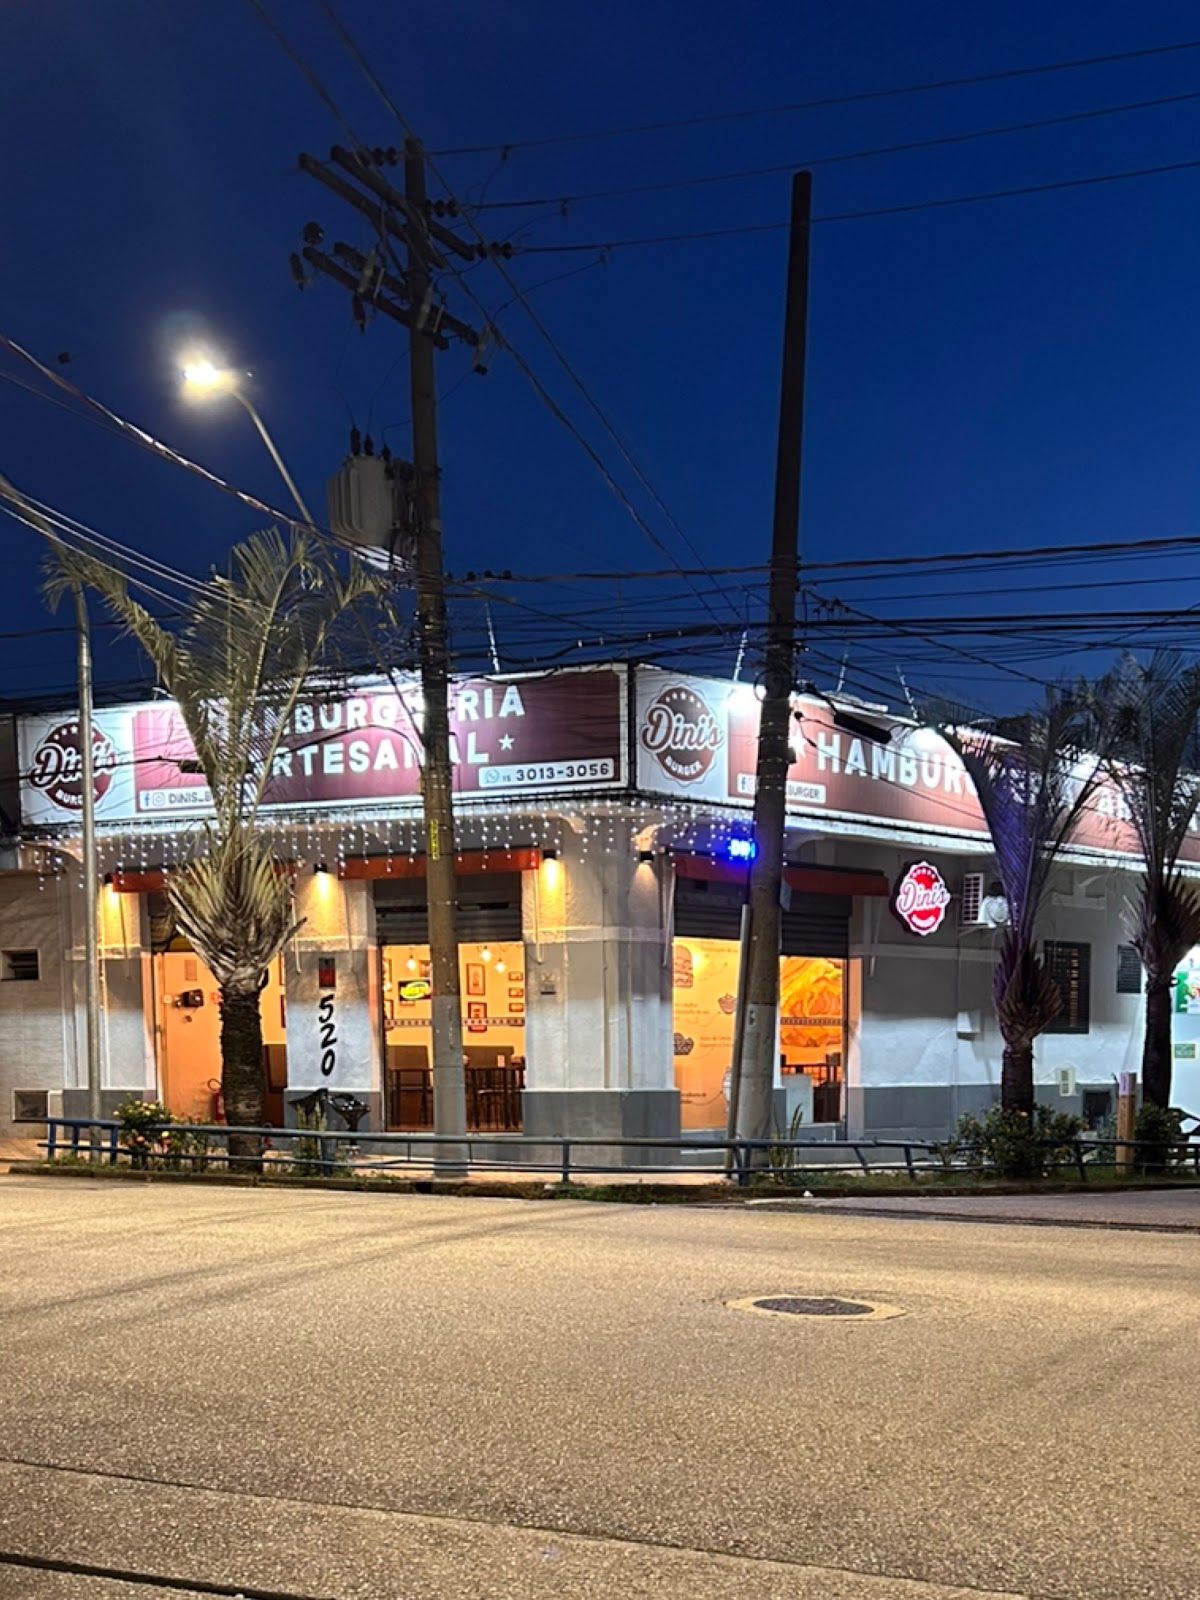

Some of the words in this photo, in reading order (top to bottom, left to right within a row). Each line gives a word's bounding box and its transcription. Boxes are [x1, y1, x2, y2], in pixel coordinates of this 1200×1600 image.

[205, 684, 526, 746] BURGRIA
[641, 704, 724, 752] Dini's
[516, 762, 610, 782] 3013-3056
[665, 755, 703, 776] BURGER
[897, 881, 948, 914] Dini's
[318, 994, 338, 1077] 520
